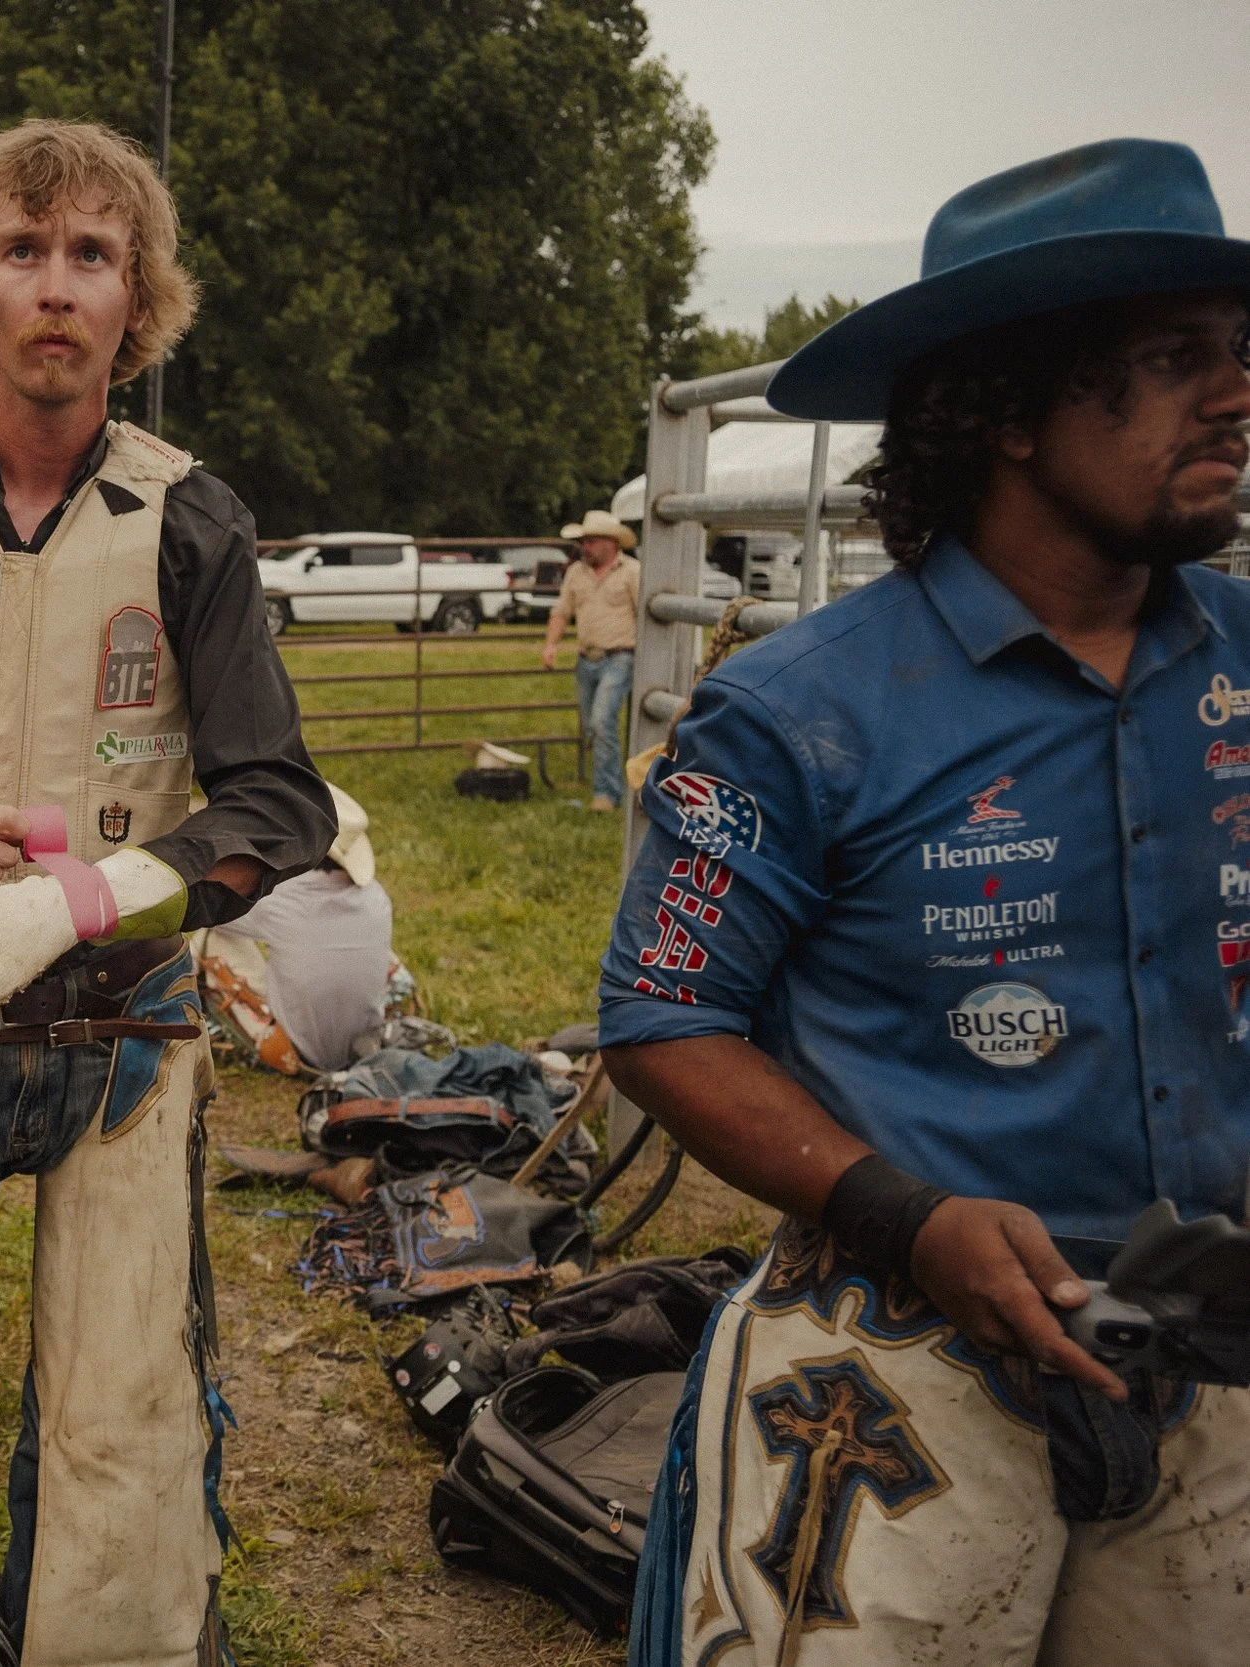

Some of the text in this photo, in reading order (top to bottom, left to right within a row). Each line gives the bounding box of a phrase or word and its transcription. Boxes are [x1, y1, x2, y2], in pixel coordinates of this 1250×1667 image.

[922, 836, 1060, 870] Hennessy
[922, 892, 1060, 934] PENDLETON
[955, 926, 1027, 942] WHISKY
[1006, 944, 1066, 963] ULTRA
[950, 1007, 1065, 1038] BUSCH
[978, 1038, 1043, 1052] LIGHT
